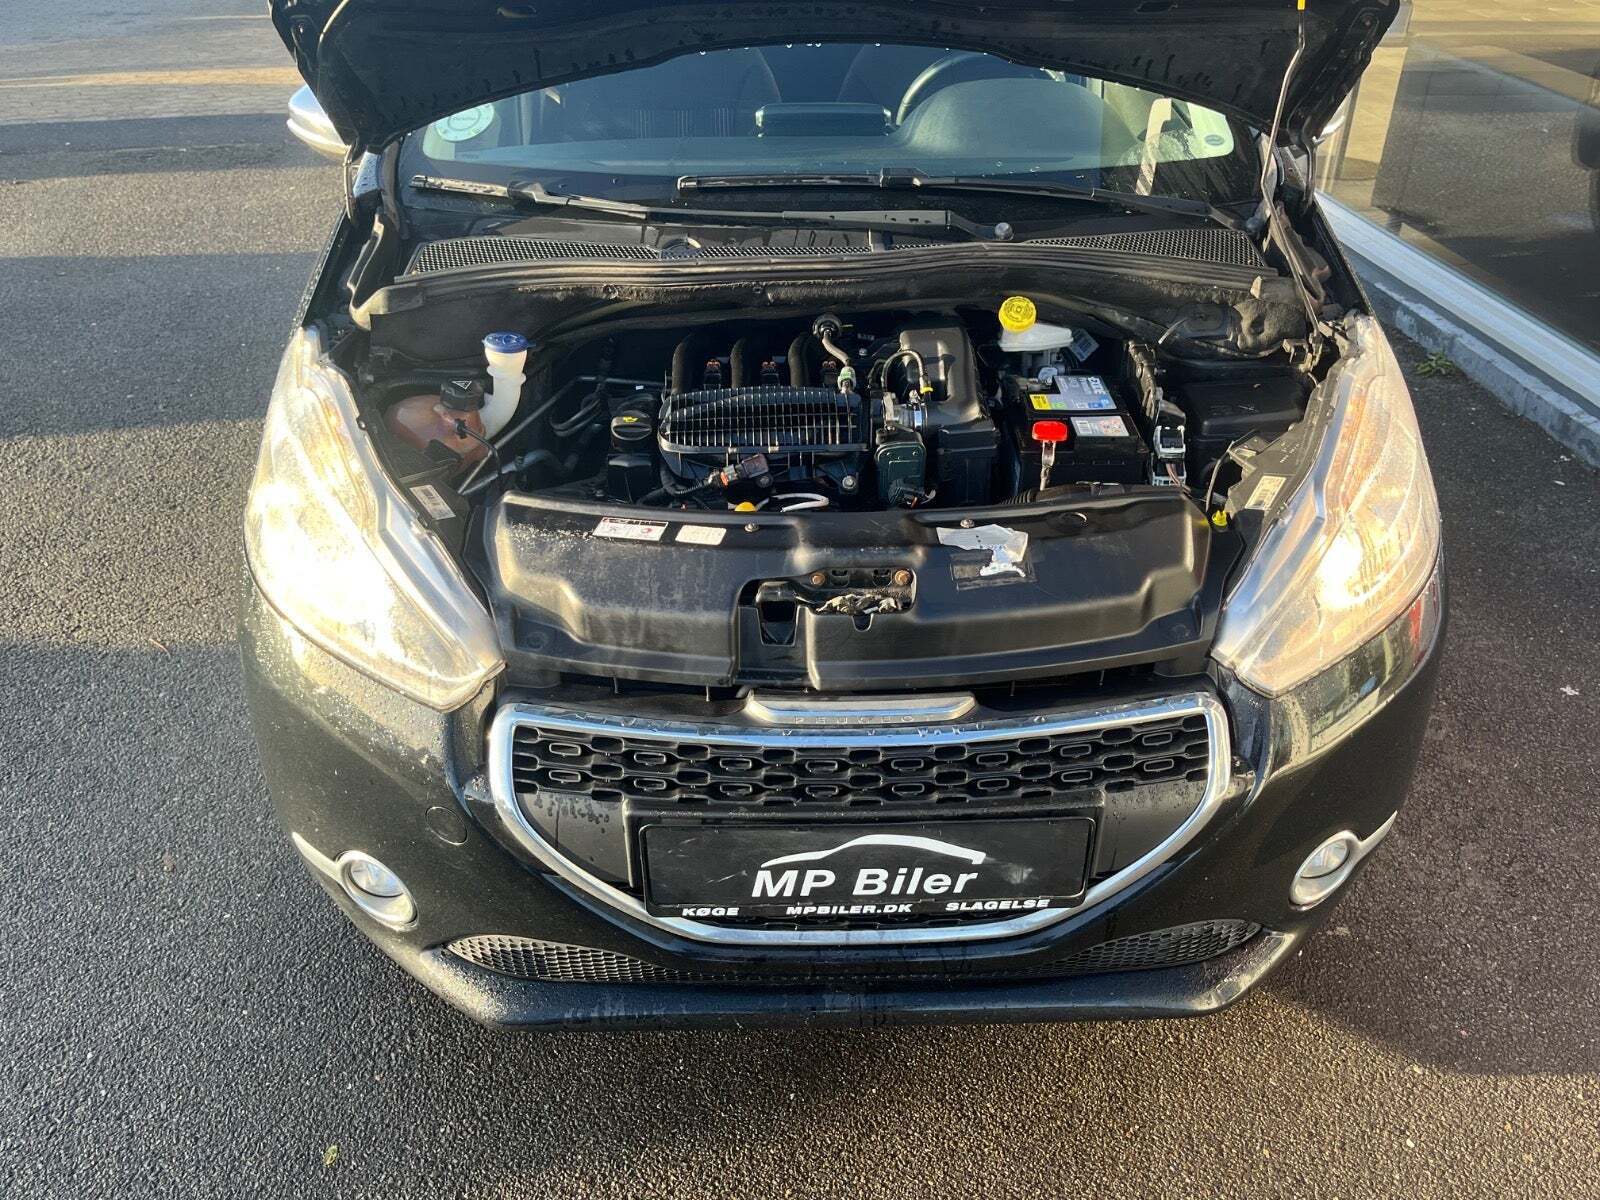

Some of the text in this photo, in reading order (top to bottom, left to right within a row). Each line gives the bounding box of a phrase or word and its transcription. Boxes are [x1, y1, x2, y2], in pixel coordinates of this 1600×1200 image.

[751, 867, 979, 898] MP Biler
[681, 899, 1050, 917] KØGE MPBILER.DK SLAGELSE
